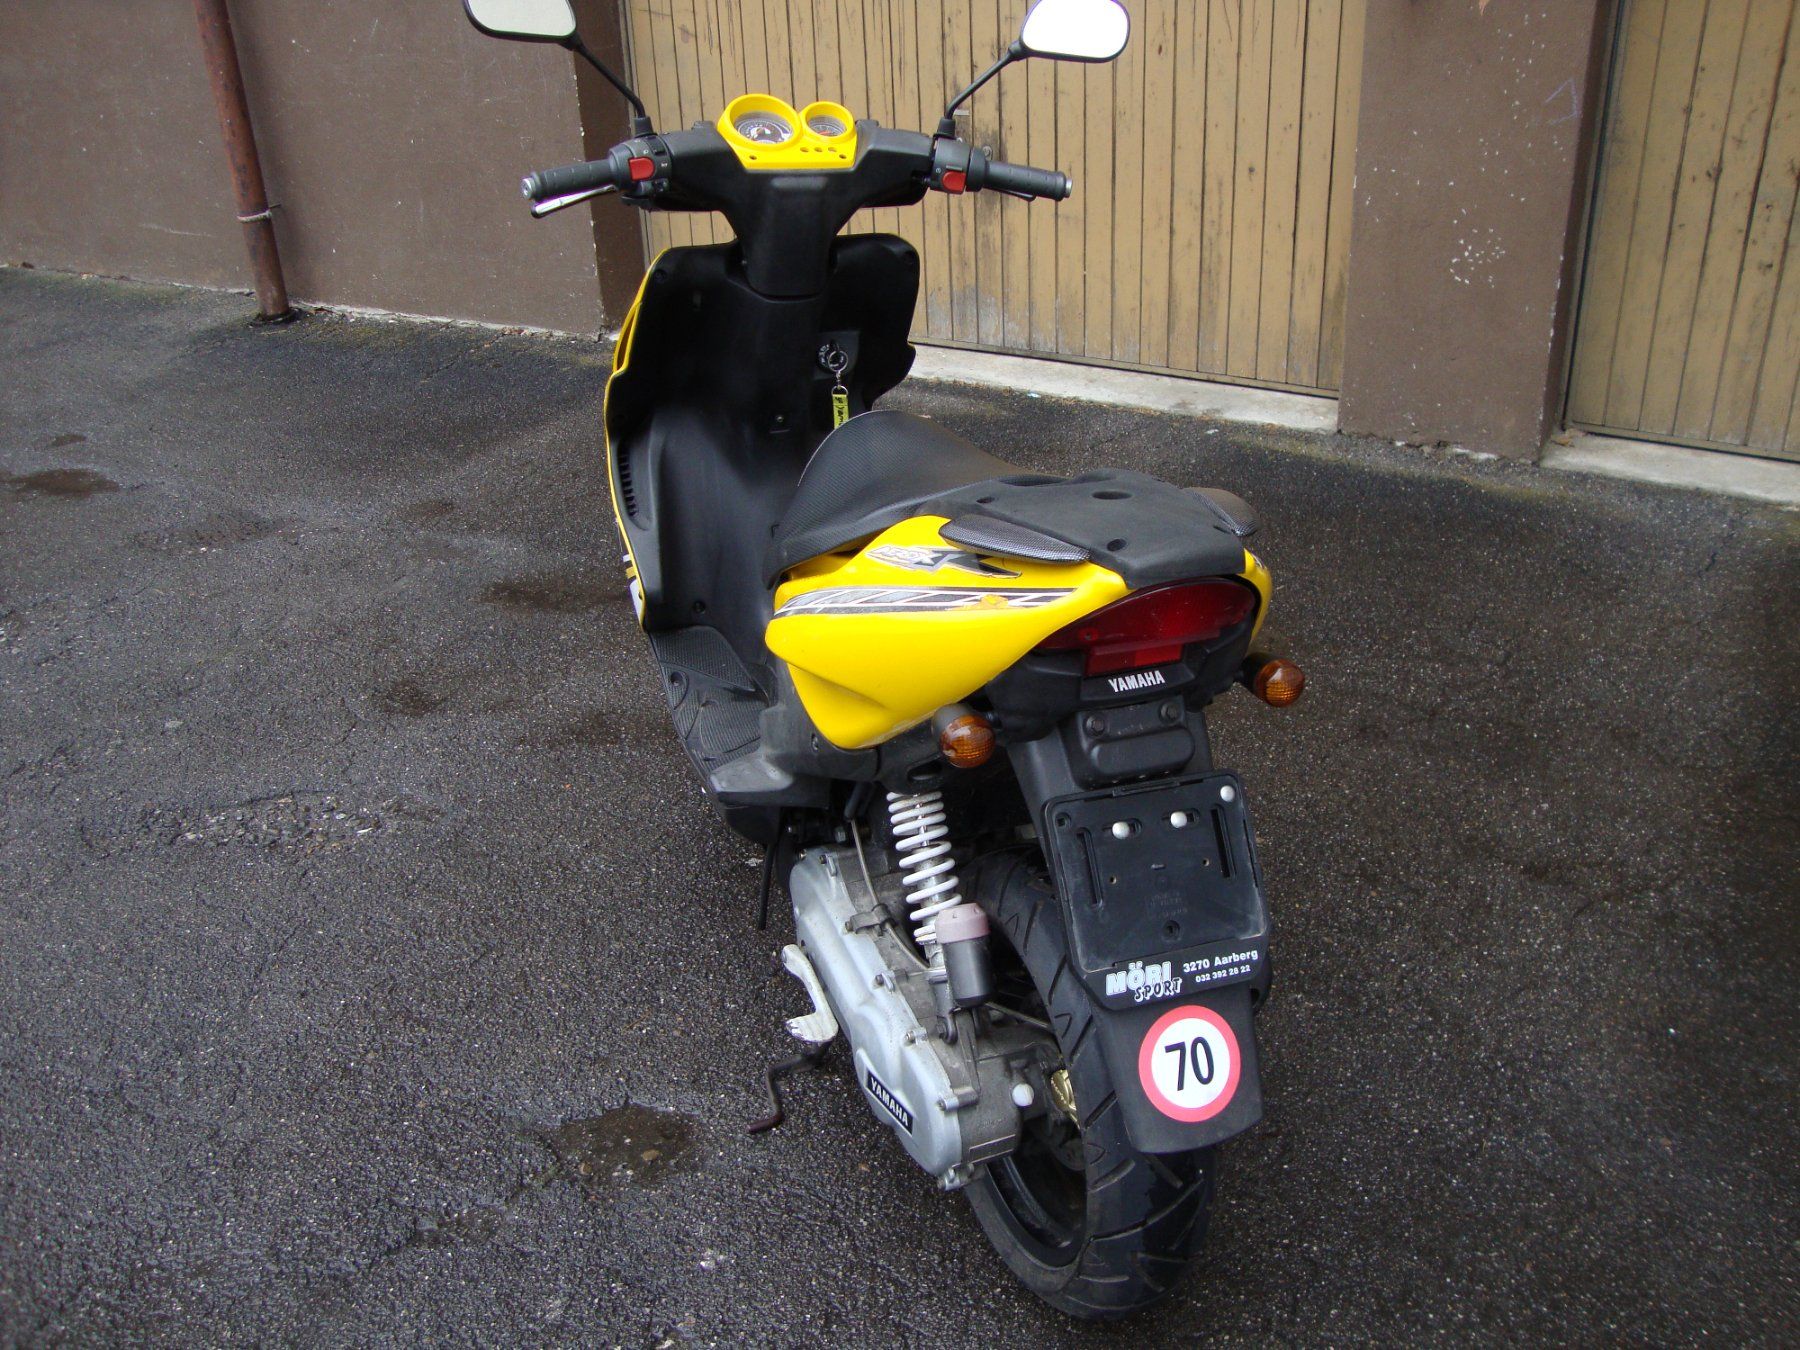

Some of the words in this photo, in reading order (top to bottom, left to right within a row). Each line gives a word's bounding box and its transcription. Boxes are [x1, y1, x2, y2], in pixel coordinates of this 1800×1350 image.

[1108, 670, 1166, 692] YAMAHA
[1183, 959, 1210, 973] 3270
[1214, 950, 1258, 966] Aarberg
[1195, 973, 1211, 983] 032
[1212, 969, 1227, 979] 392
[1240, 964, 1251, 973] 22
[1132, 977, 1182, 1002] SPORT
[1164, 1036, 1214, 1091] 70
[871, 1076, 908, 1127] YAMAHA
